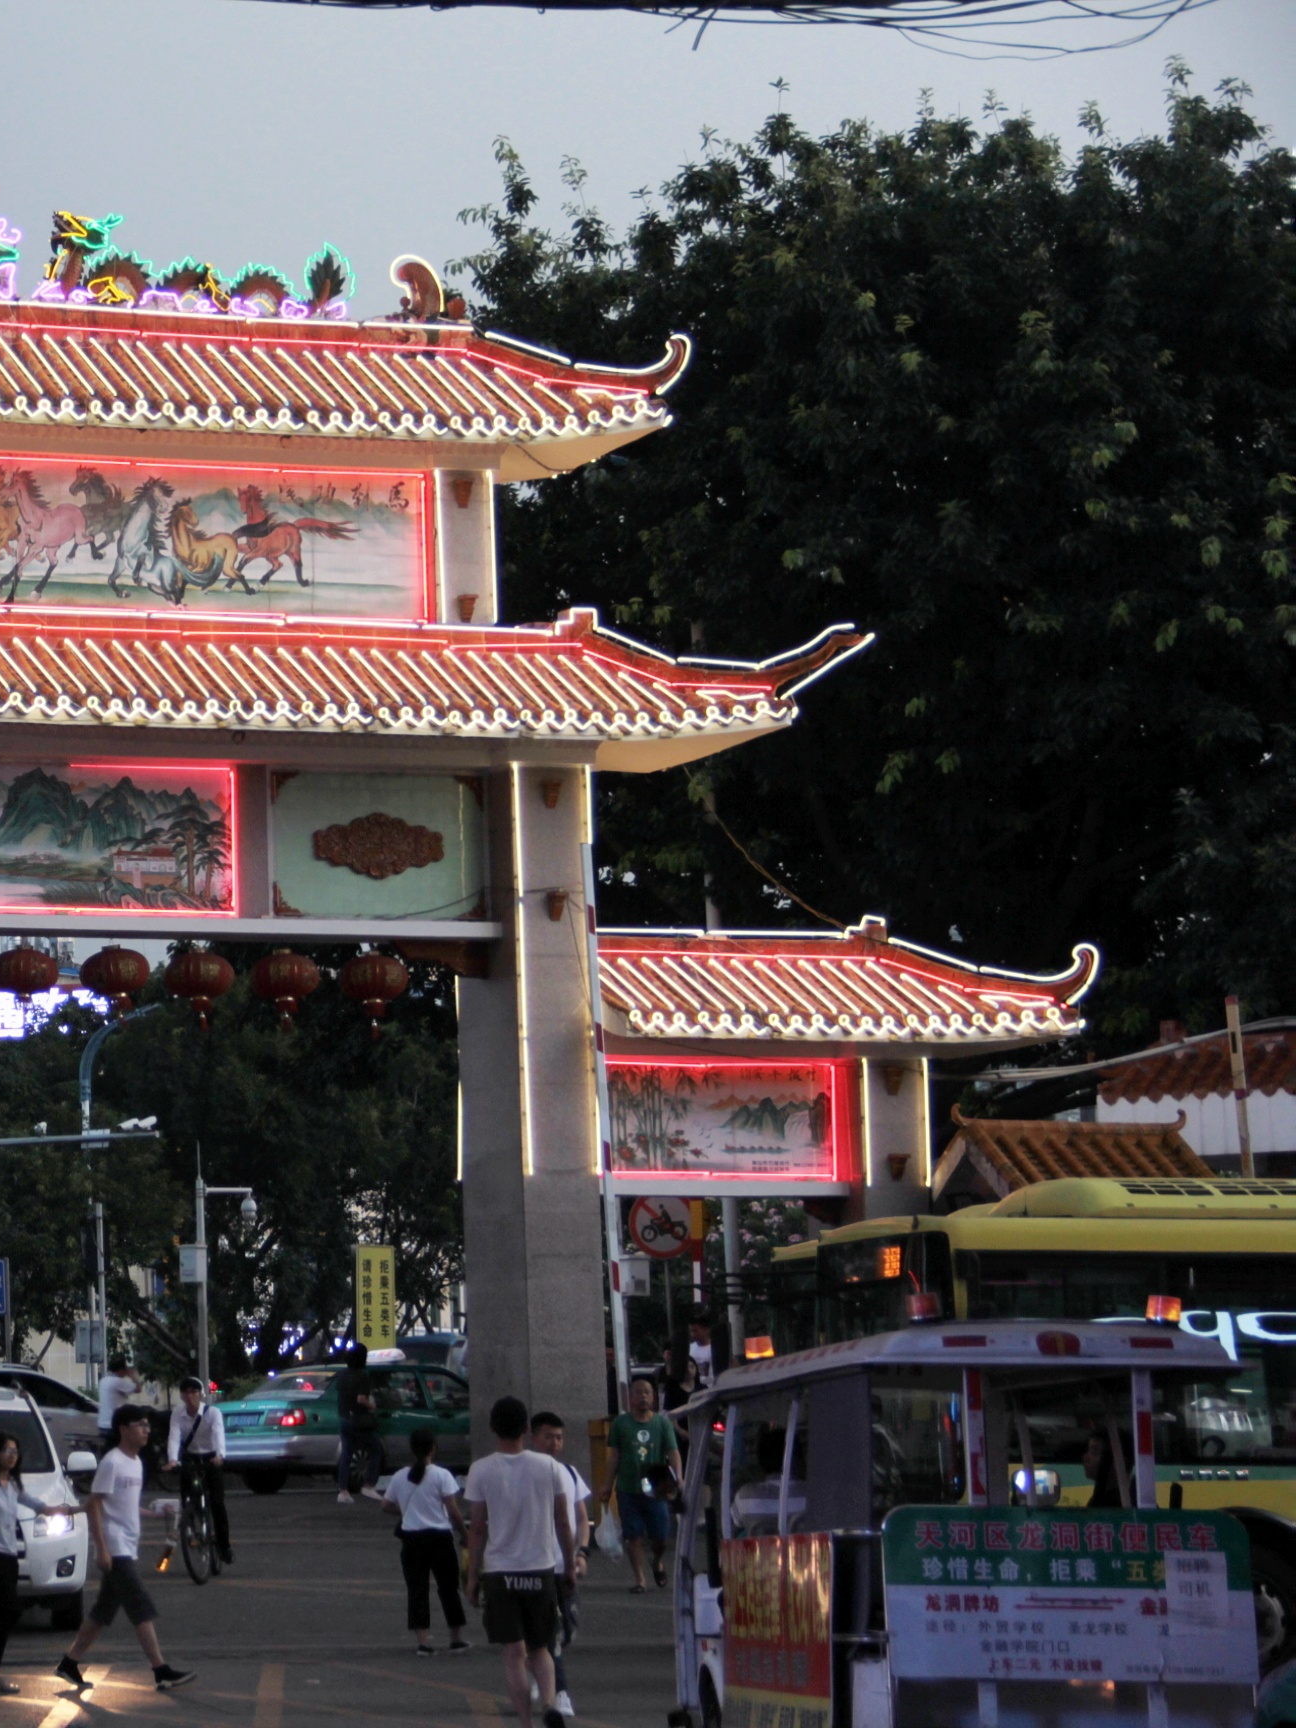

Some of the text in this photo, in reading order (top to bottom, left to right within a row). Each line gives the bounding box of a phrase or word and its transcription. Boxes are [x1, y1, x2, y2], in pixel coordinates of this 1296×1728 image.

[362, 1258, 372, 1337] 请珍惜生命
[380, 1259, 390, 1338] 拒乘五类车
[915, 1521, 1217, 1552] 天河区龙洞街便民车
[925, 1594, 1000, 1613] 龙洞牌坊
[1178, 1581, 1213, 1597] 司机
